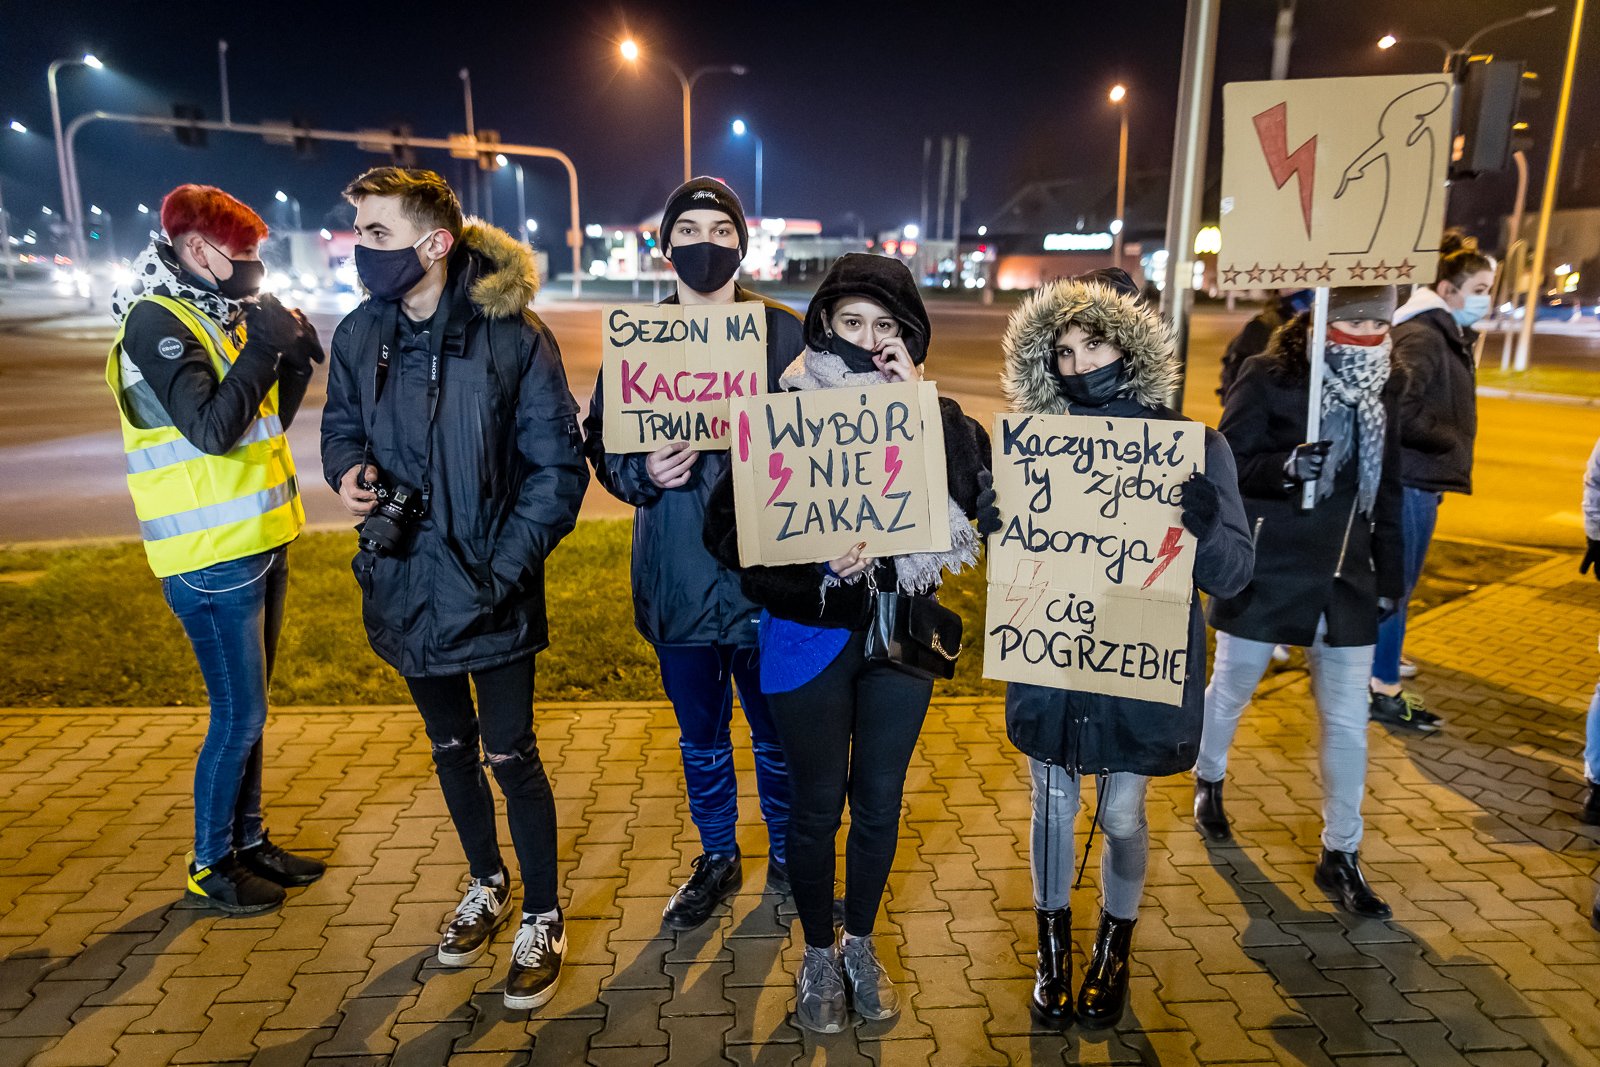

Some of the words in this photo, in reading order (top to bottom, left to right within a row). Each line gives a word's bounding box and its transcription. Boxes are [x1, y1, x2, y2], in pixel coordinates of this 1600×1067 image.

[609, 309, 709, 347] SEZON
[726, 313, 760, 342] NA
[621, 360, 758, 404] KACZKI
[766, 394, 914, 449] WYBÓR
[1003, 415, 1184, 474] Kaczyński
[809, 449, 872, 488] NIE
[1014, 457, 1051, 513] Ty
[774, 491, 916, 541] ZAKAZ
[1000, 513, 1155, 584] Aborcja
[1046, 593, 1096, 634] cię
[989, 624, 1187, 685] POGRZEBIE
